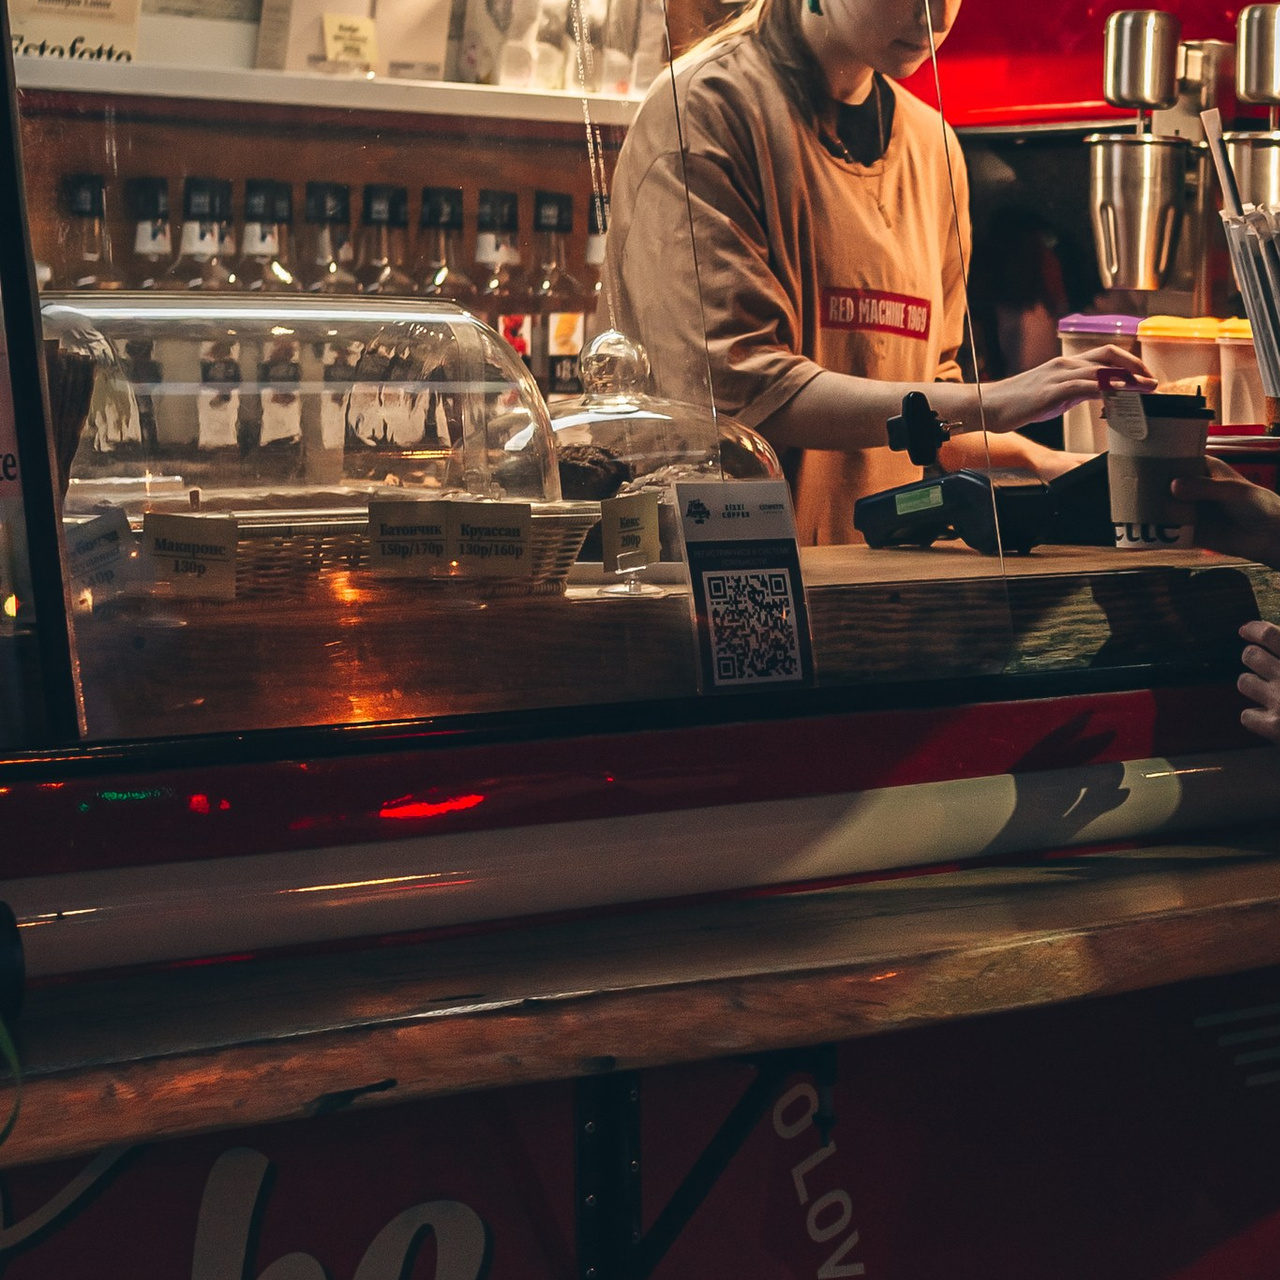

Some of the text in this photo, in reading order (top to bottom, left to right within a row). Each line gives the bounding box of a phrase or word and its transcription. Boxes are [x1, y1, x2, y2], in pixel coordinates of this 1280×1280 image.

[829, 295, 855, 322] RED
[858, 298, 907, 329] MACHINE
[461, 523, 521, 540] Круассан
